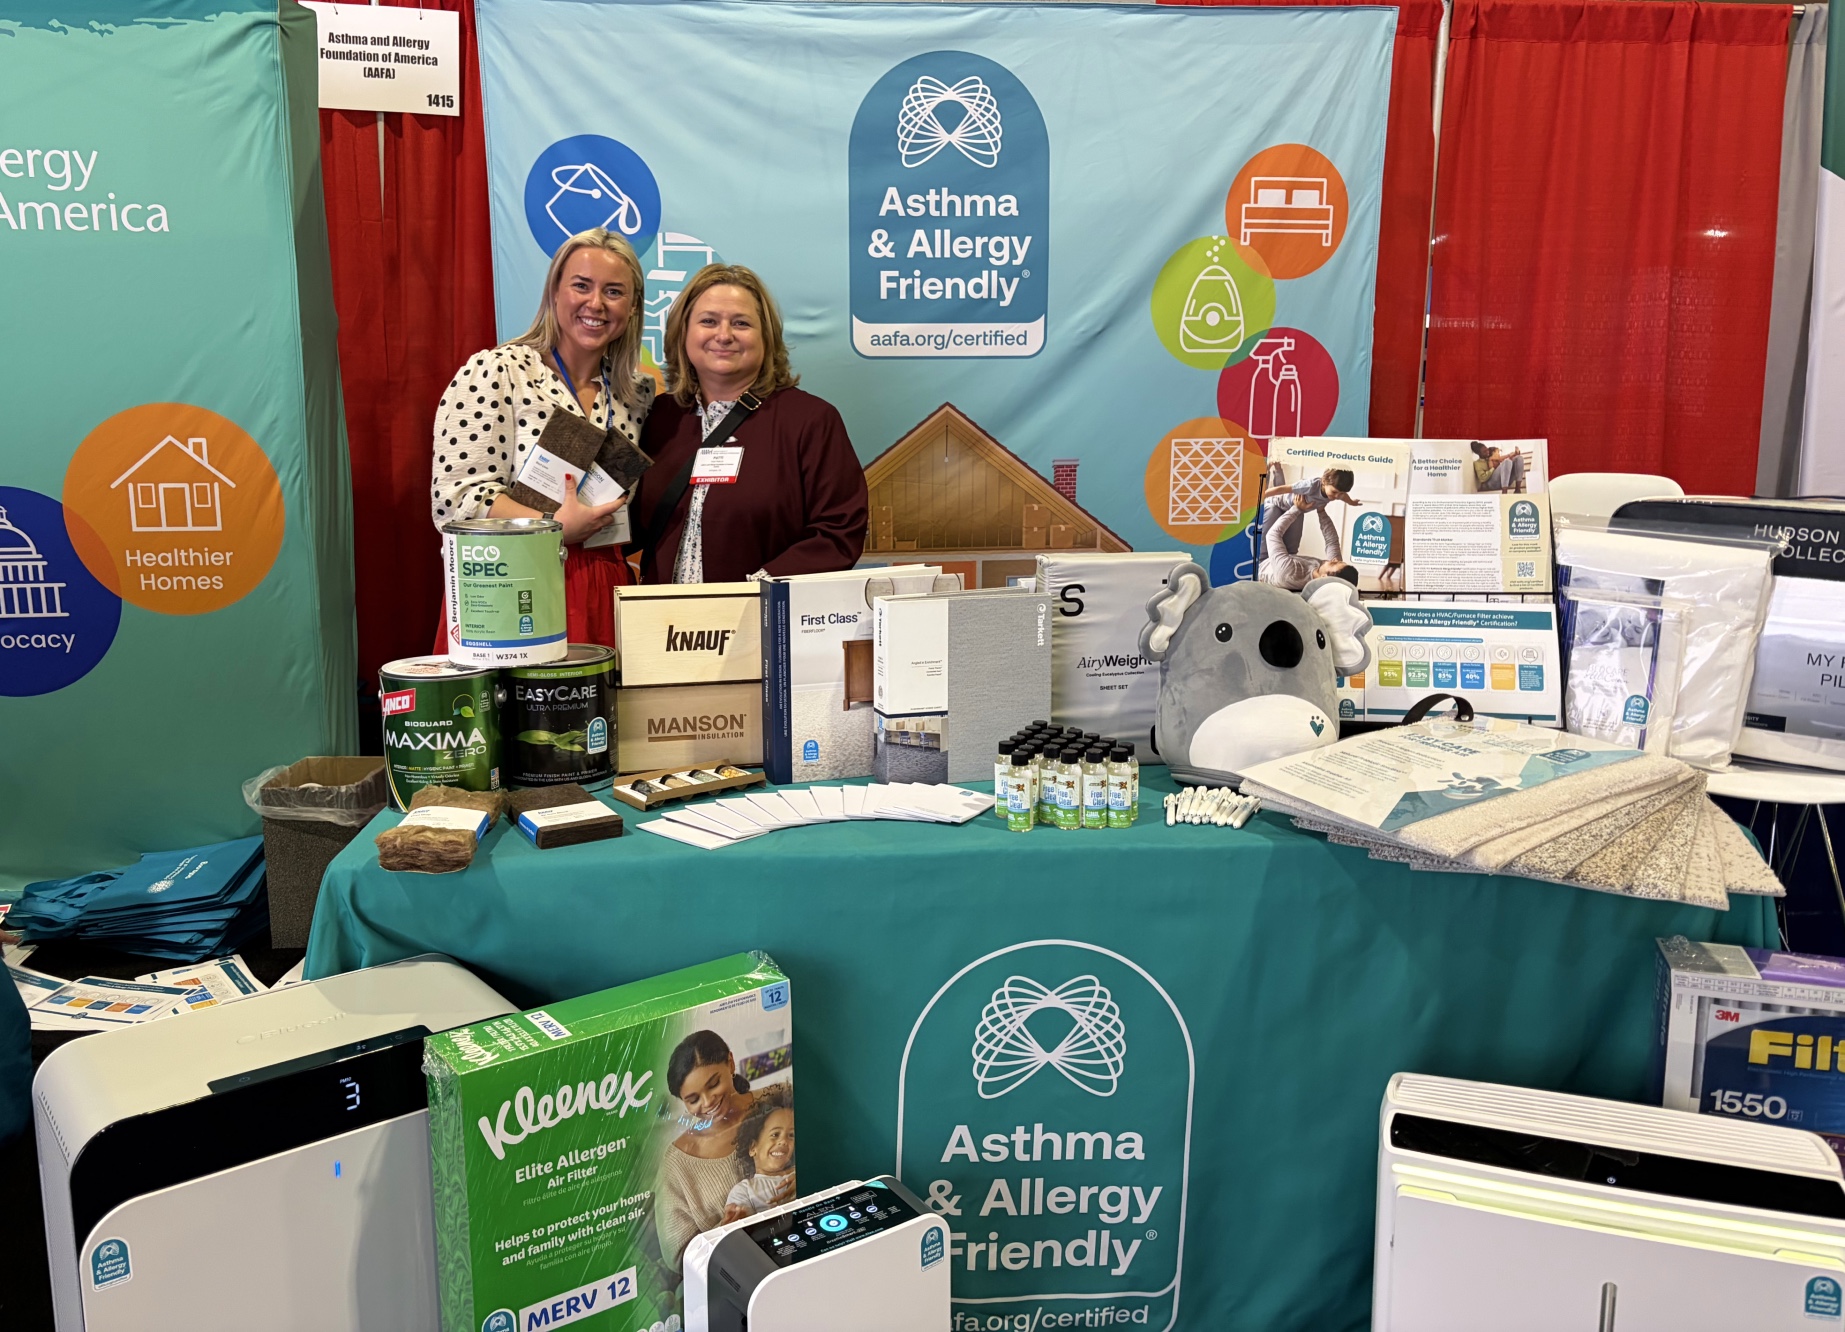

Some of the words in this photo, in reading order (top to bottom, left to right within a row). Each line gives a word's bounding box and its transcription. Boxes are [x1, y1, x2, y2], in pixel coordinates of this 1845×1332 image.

[328, 32, 368, 45] Asthma
[370, 35, 390, 46] and
[392, 36, 430, 50] Allergy
[320, 48, 379, 62] Foundation
[382, 52, 392, 63] of
[394, 53, 438, 66] America
[363, 67, 395, 79] (AAFA)
[426, 94, 454, 108] 1415
[879, 187, 1019, 217] Asthma
[867, 228, 895, 259] &
[907, 229, 1032, 266] Allergy
[870, 329, 1028, 350] aafa.org/certified
[1286, 448, 1325, 457] Certified
[1326, 451, 1366, 461] Products
[1367, 455, 1394, 464] Guide
[1357, 533, 1386, 541] Asthma
[1754, 523, 1840, 545] HUDSON
[462, 545, 500, 561] ECO
[1362, 540, 1388, 550] Allergy
[125, 547, 234, 567] Healthier
[462, 562, 509, 577] SPEC
[140, 573, 224, 591] Homes
[450, 576, 458, 622] Benjamin
[1059, 584, 1086, 617] S
[801, 614, 825, 626] First
[1436, 611, 1476, 619] HVAC/Furnace
[1037, 613, 1045, 647] Tarkett
[1807, 652, 1835, 667] MY
[553, 702, 588, 711] PREMIUM
[648, 714, 747, 735] MANSON
[386, 728, 487, 750] MAXIMA
[697, 731, 744, 741] INSULATION
[443, 746, 487, 760] ZERO
[768, 991, 782, 1003] 12
[530, 1012, 545, 1020] 12
[1714, 1009, 1740, 1023] 3M
[538, 1020, 566, 1037] MERV
[345, 1082, 360, 1111] 3
[1710, 1089, 1787, 1119] 1550
[478, 1070, 653, 1160] Kleenex
[940, 1123, 1146, 1163] Asthma
[515, 1161, 553, 1184] Elite
[547, 1176, 565, 1189] Air
[567, 1165, 598, 1183] Filter
[522, 1195, 541, 1207] Filtro
[568, 1183, 580, 1192] aire
[581, 1179, 589, 1187] de
[925, 1179, 963, 1217] &
[979, 1177, 1163, 1224] Allergy
[495, 1231, 530, 1252] Helps
[532, 1227, 545, 1238] to
[547, 1210, 590, 1236] protect
[592, 1201, 619, 1220] your
[620, 1190, 650, 1208] home
[502, 1251, 525, 1266] and
[527, 1236, 565, 1258] family
[567, 1226, 594, 1242] with
[596, 1215, 626, 1232] clean
[627, 1207, 645, 1221] air.
[526, 1255, 548, 1267] Ayuda
[554, 1242, 583, 1257] proteger
[565, 1254, 576, 1262] con
[577, 1249, 590, 1258] aire
[924, 1241, 941, 1252] Asthma
[928, 1246, 942, 1256] Allergy
[98, 1257, 124, 1269] Asthma
[924, 1252, 941, 1264] Friendly
[98, 1268, 126, 1281] Friendly
[103, 1262, 127, 1273] Allergy
[527, 1289, 598, 1332] MERV
[607, 1277, 631, 1300] 12
